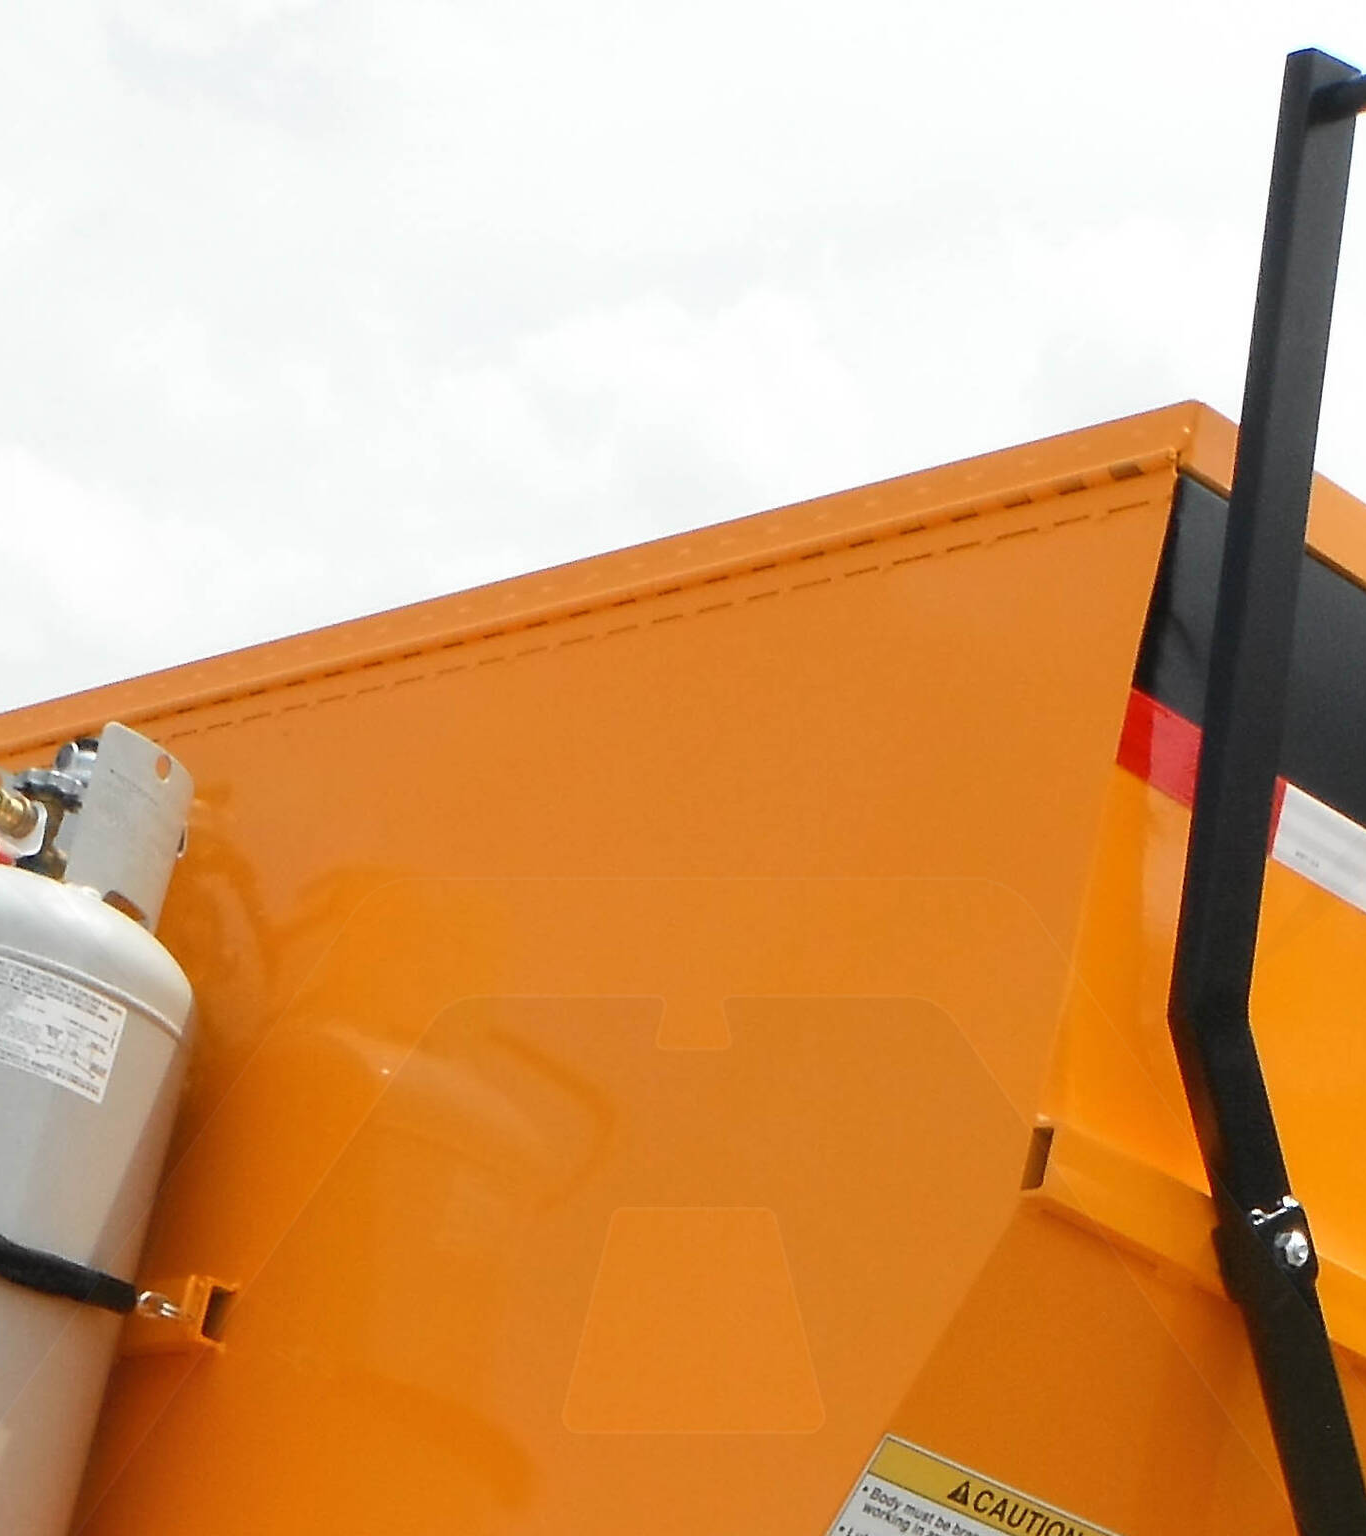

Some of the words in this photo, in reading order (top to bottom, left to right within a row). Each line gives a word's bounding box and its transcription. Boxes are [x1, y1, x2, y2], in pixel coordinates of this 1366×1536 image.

[862, 1503, 911, 1532] working
[912, 1523, 925, 1536] in
[869, 1486, 901, 1511] Body
[903, 1503, 935, 1524] must
[933, 1515, 951, 1531] be
